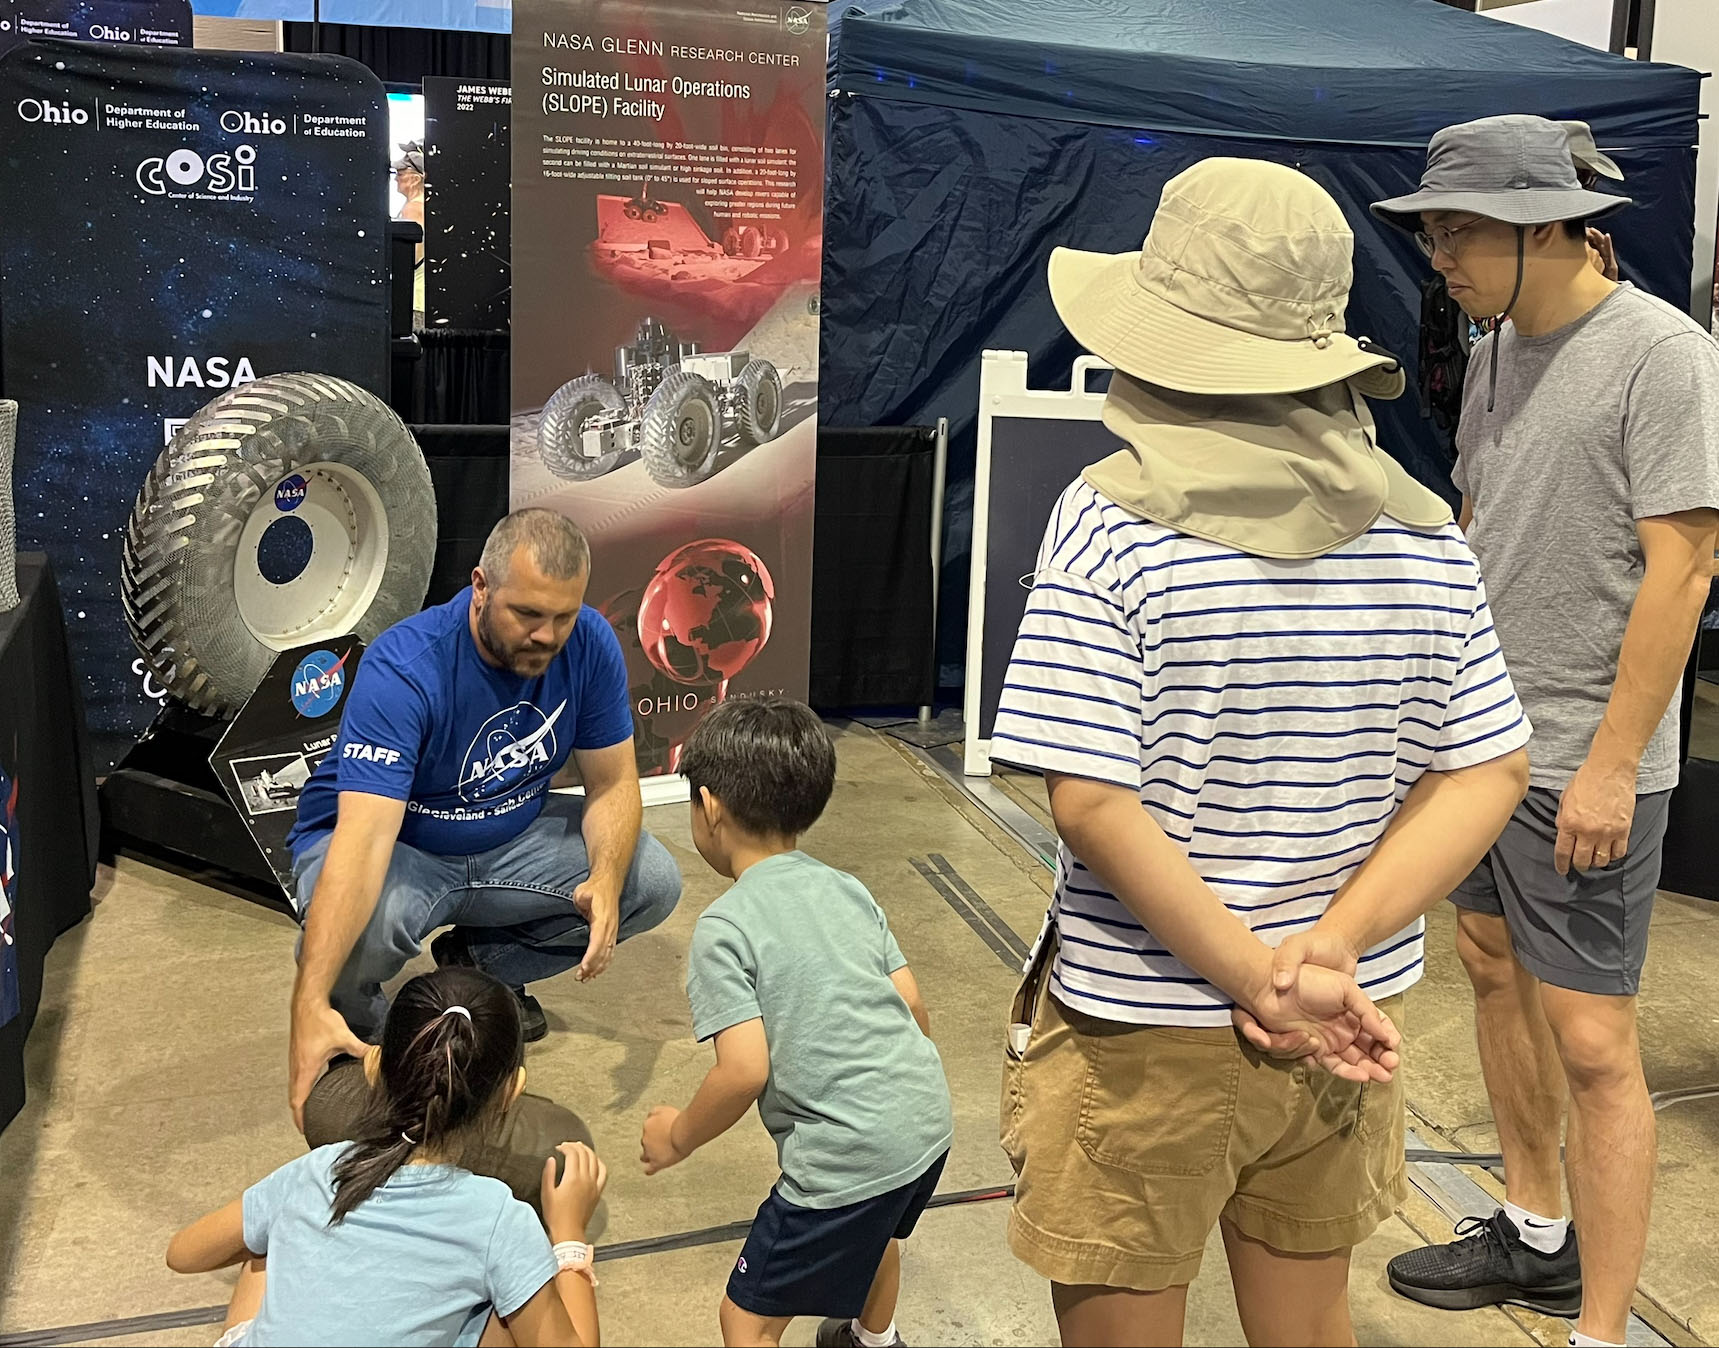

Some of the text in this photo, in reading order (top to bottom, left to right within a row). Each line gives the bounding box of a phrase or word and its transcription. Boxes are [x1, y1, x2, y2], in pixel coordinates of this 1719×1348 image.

[90, 24, 130, 41] Ohio
[140, 28, 178, 38] Department
[146, 36, 178, 45] Education
[544, 32, 800, 66] NASA GLENN RESEARCH CENTER
[456, 85, 486, 94] JAMES
[542, 66, 750, 99] Simulated Lunar Operations
[473, 96, 500, 104] WEBB'S
[542, 93, 665, 121] (SLOPE) Facility
[18, 98, 88, 124] Ohio
[105, 104, 186, 118] Department of
[106, 117, 200, 132] Higher Education
[220, 110, 286, 135] Ohio
[304, 114, 366, 125] Department
[314, 128, 366, 137] Education
[230, 194, 254, 204] Industry
[147, 356, 256, 388] NASA
[276, 489, 304, 498] NASA
[295, 672, 341, 696] NASA
[637, 693, 698, 716] OHIO
[303, 738, 331, 751] Lunar
[343, 743, 400, 765] STAFF
[470, 742, 549, 780] NASA
